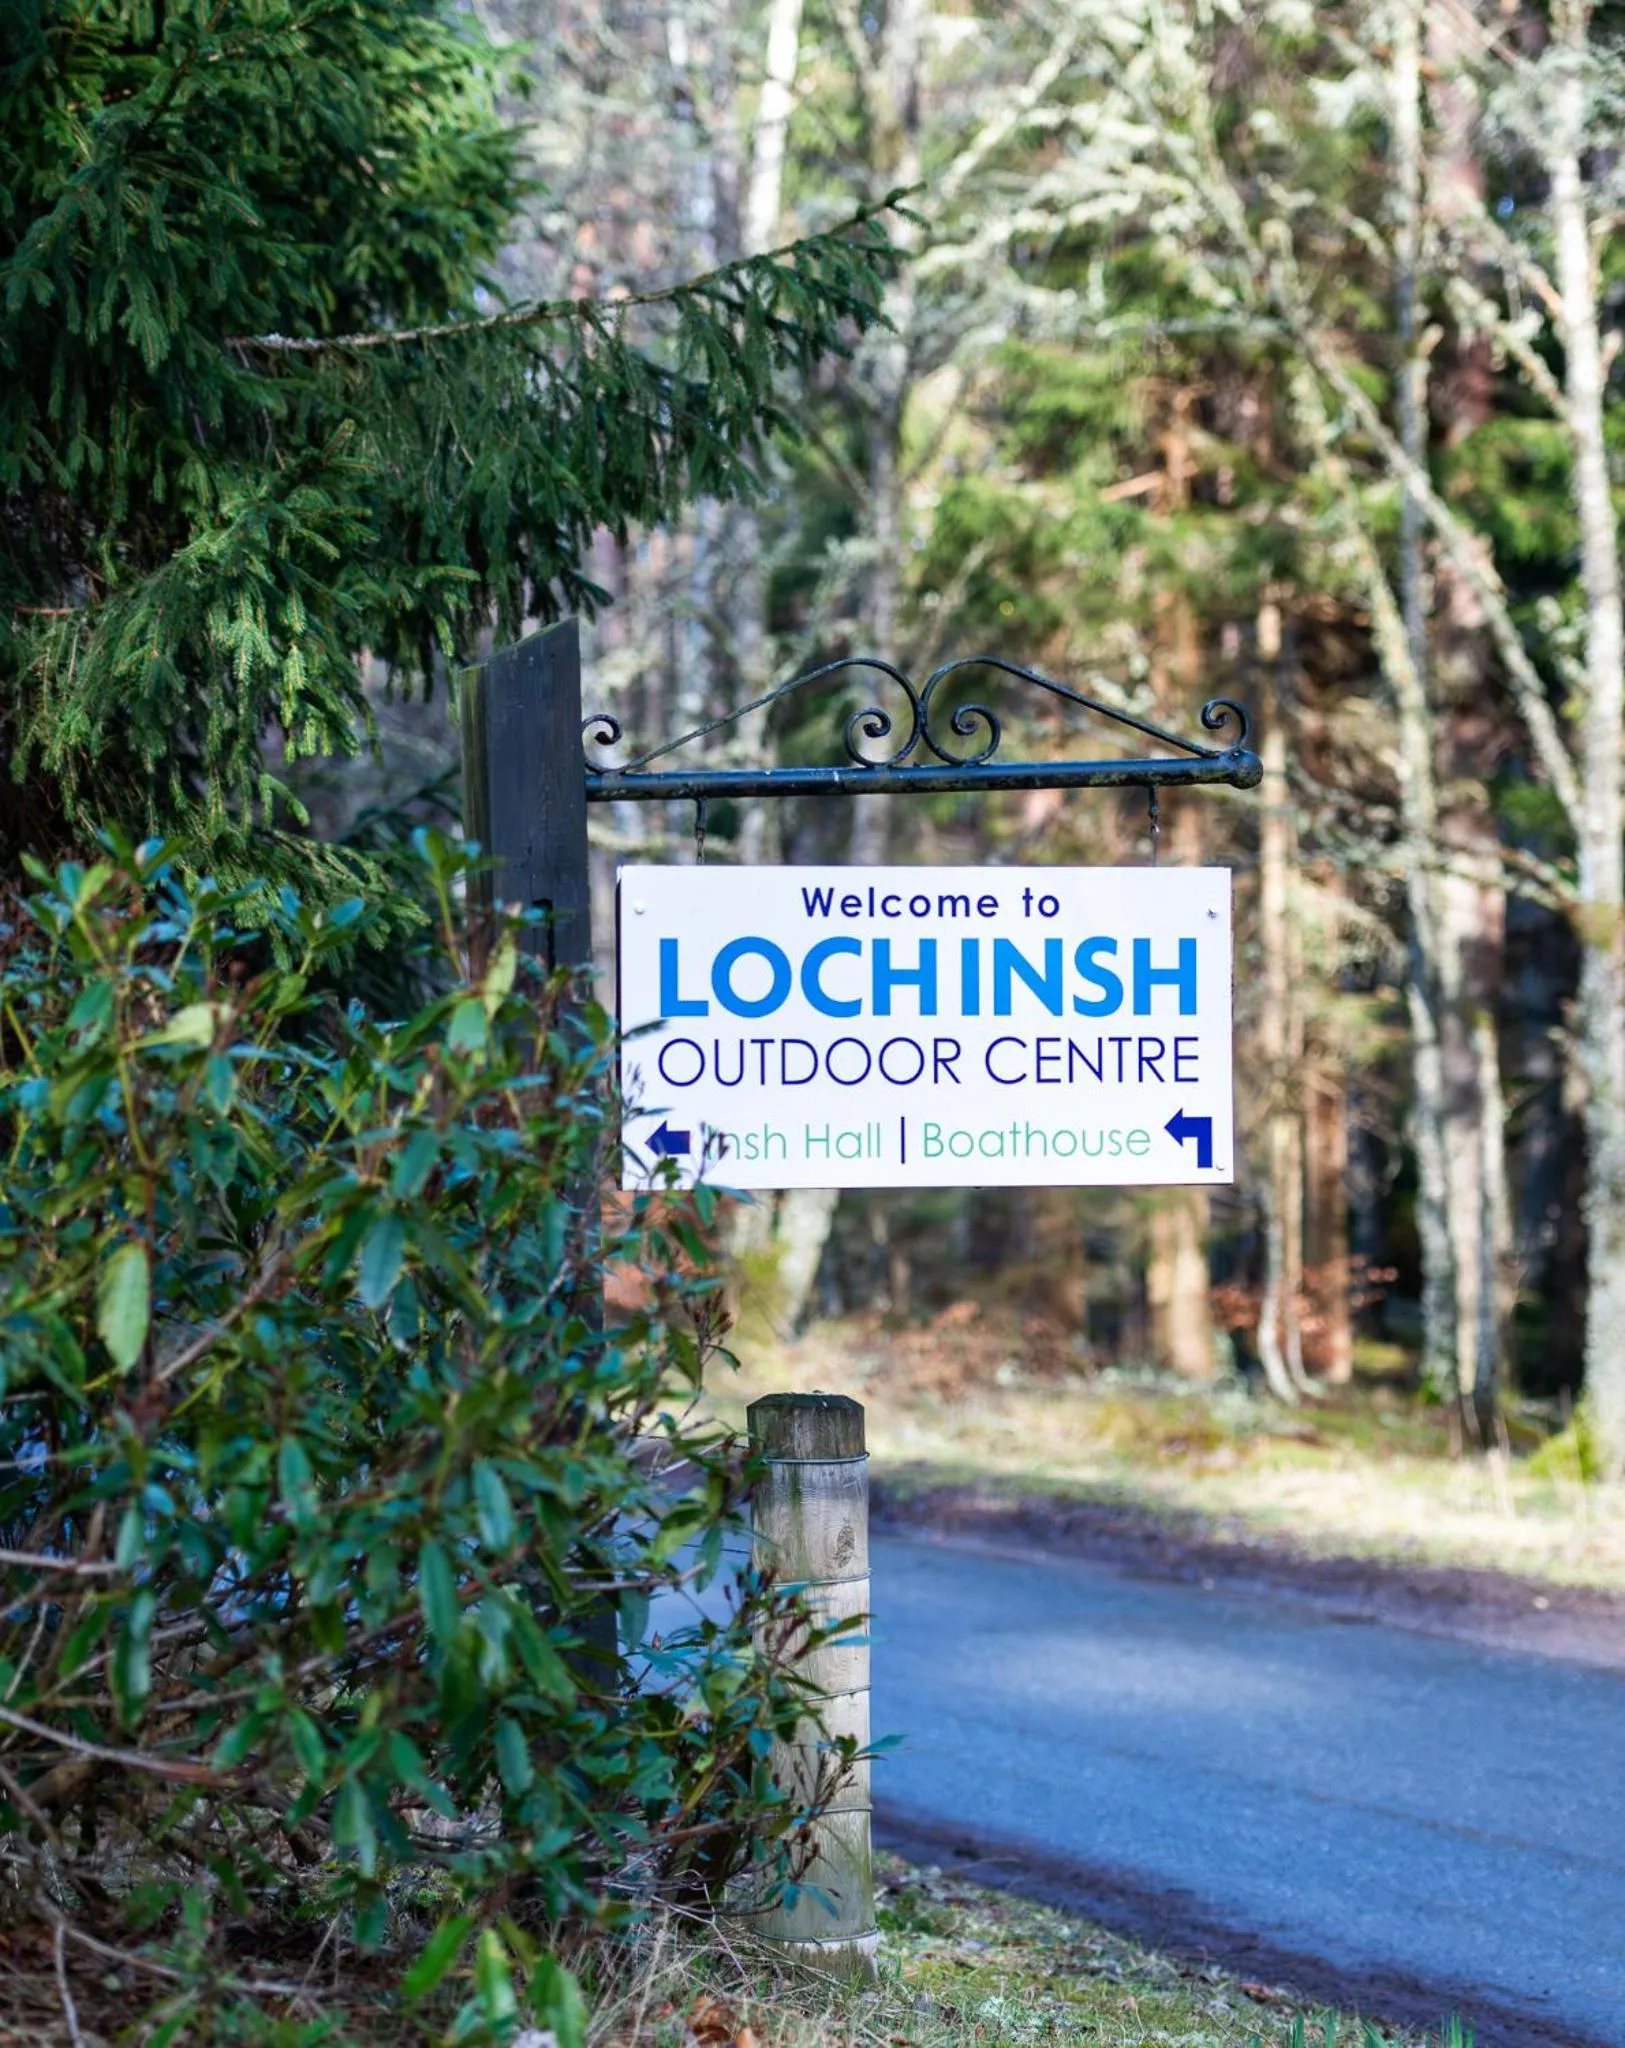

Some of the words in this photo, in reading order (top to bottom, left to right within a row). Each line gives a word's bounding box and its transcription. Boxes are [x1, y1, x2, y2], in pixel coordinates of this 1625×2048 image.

[801, 886, 999, 918] Welcome
[1022, 887, 1060, 918] to
[659, 1037, 962, 1087] OUTDOOR
[985, 1036, 1199, 1085] CENTRE
[806, 1123, 881, 1159] Hall
[923, 1121, 1151, 1158] Boathouse
